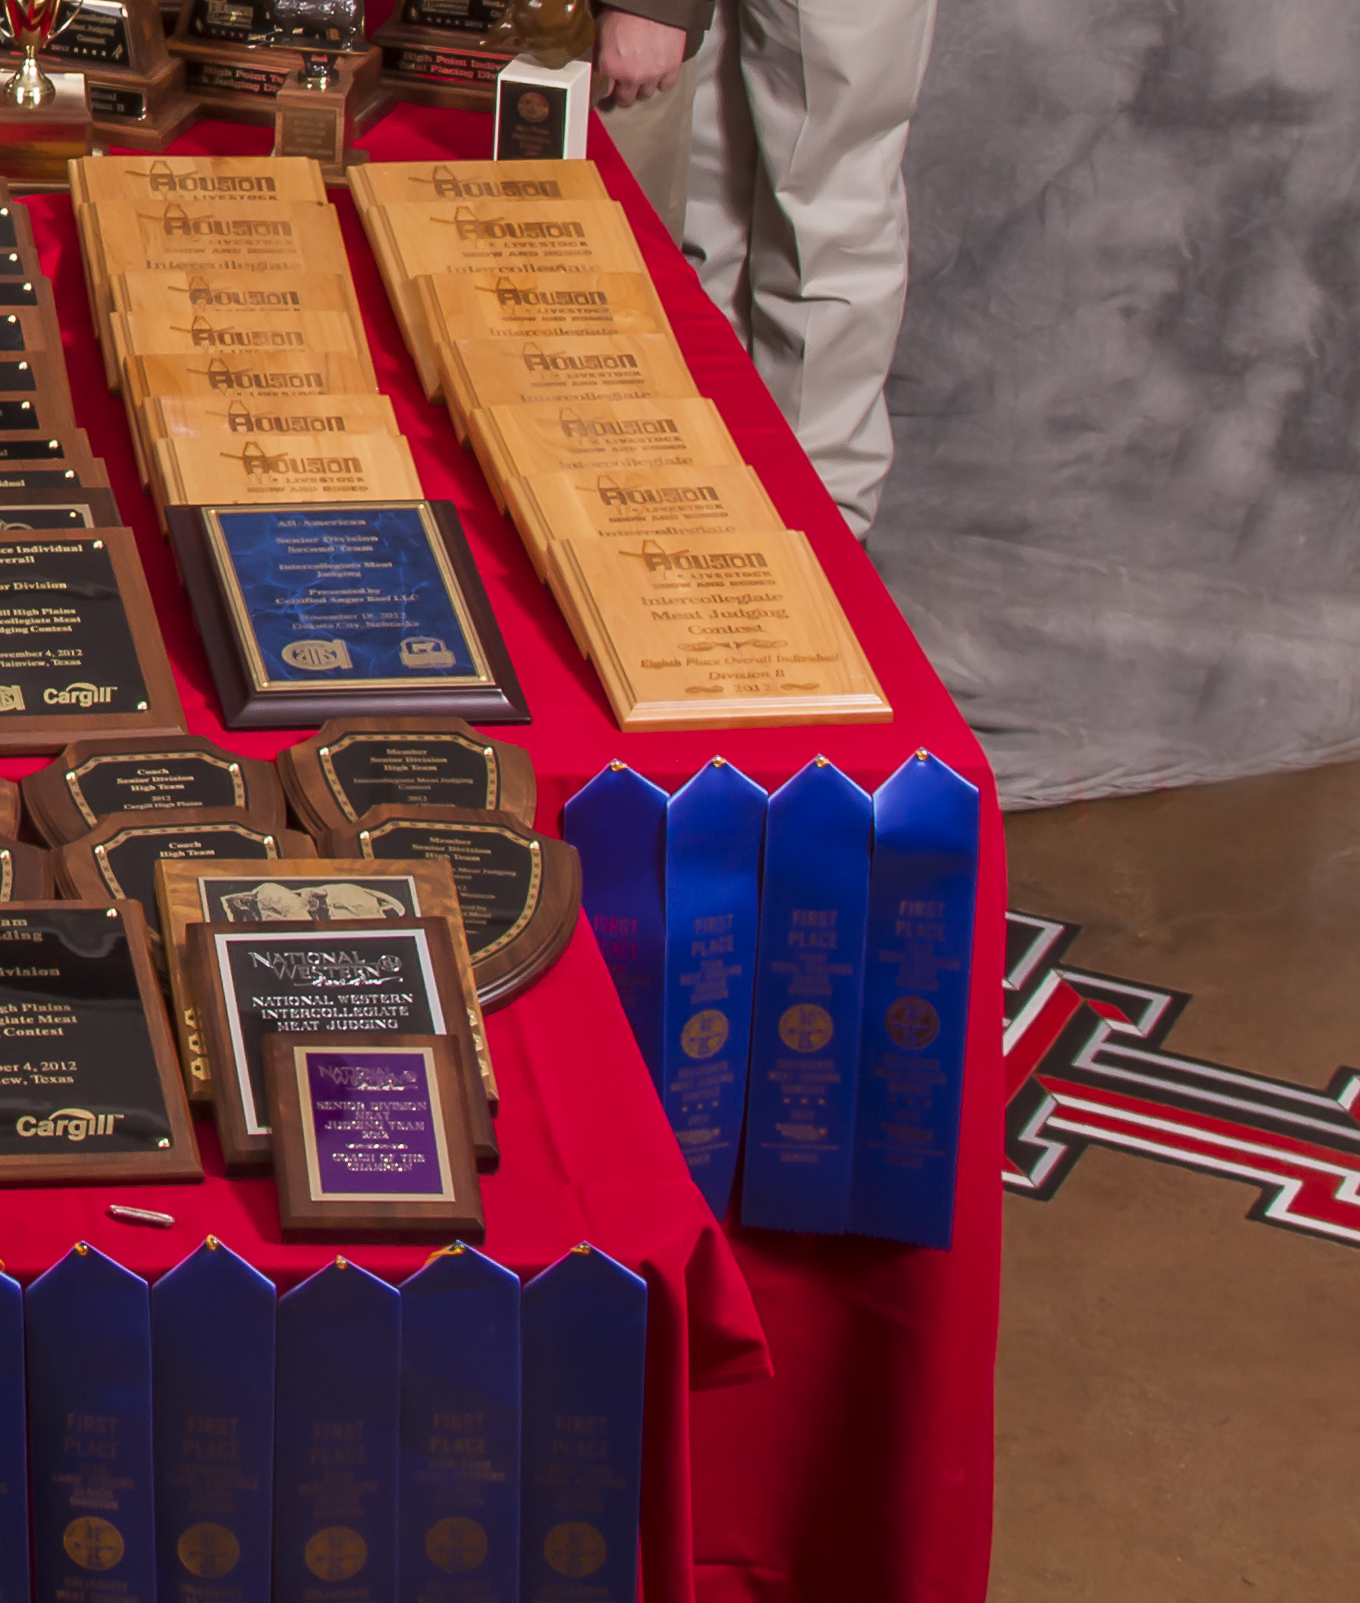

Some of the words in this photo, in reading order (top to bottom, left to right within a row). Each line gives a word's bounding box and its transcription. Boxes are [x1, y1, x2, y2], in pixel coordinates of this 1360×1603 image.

[641, 594, 783, 606] Intercollegiate
[651, 610, 703, 621] Meat
[709, 608, 789, 620] Judging
[688, 625, 766, 635] Contest
[792, 910, 837, 927] FIRST
[788, 931, 837, 949] PLACE
[249, 951, 365, 968] NATIONAL
[272, 964, 381, 980] WESTERN
[252, 995, 333, 1007] NATIONAL
[338, 993, 413, 1004] WESTERN
[262, 1006, 409, 1019] INTERCOLLEGIATE
[278, 1021, 319, 1031] MEAT
[327, 1019, 398, 1030] JUDGING
[316, 1102, 365, 1110] SENIOR
[371, 1102, 427, 1110] DIVISION
